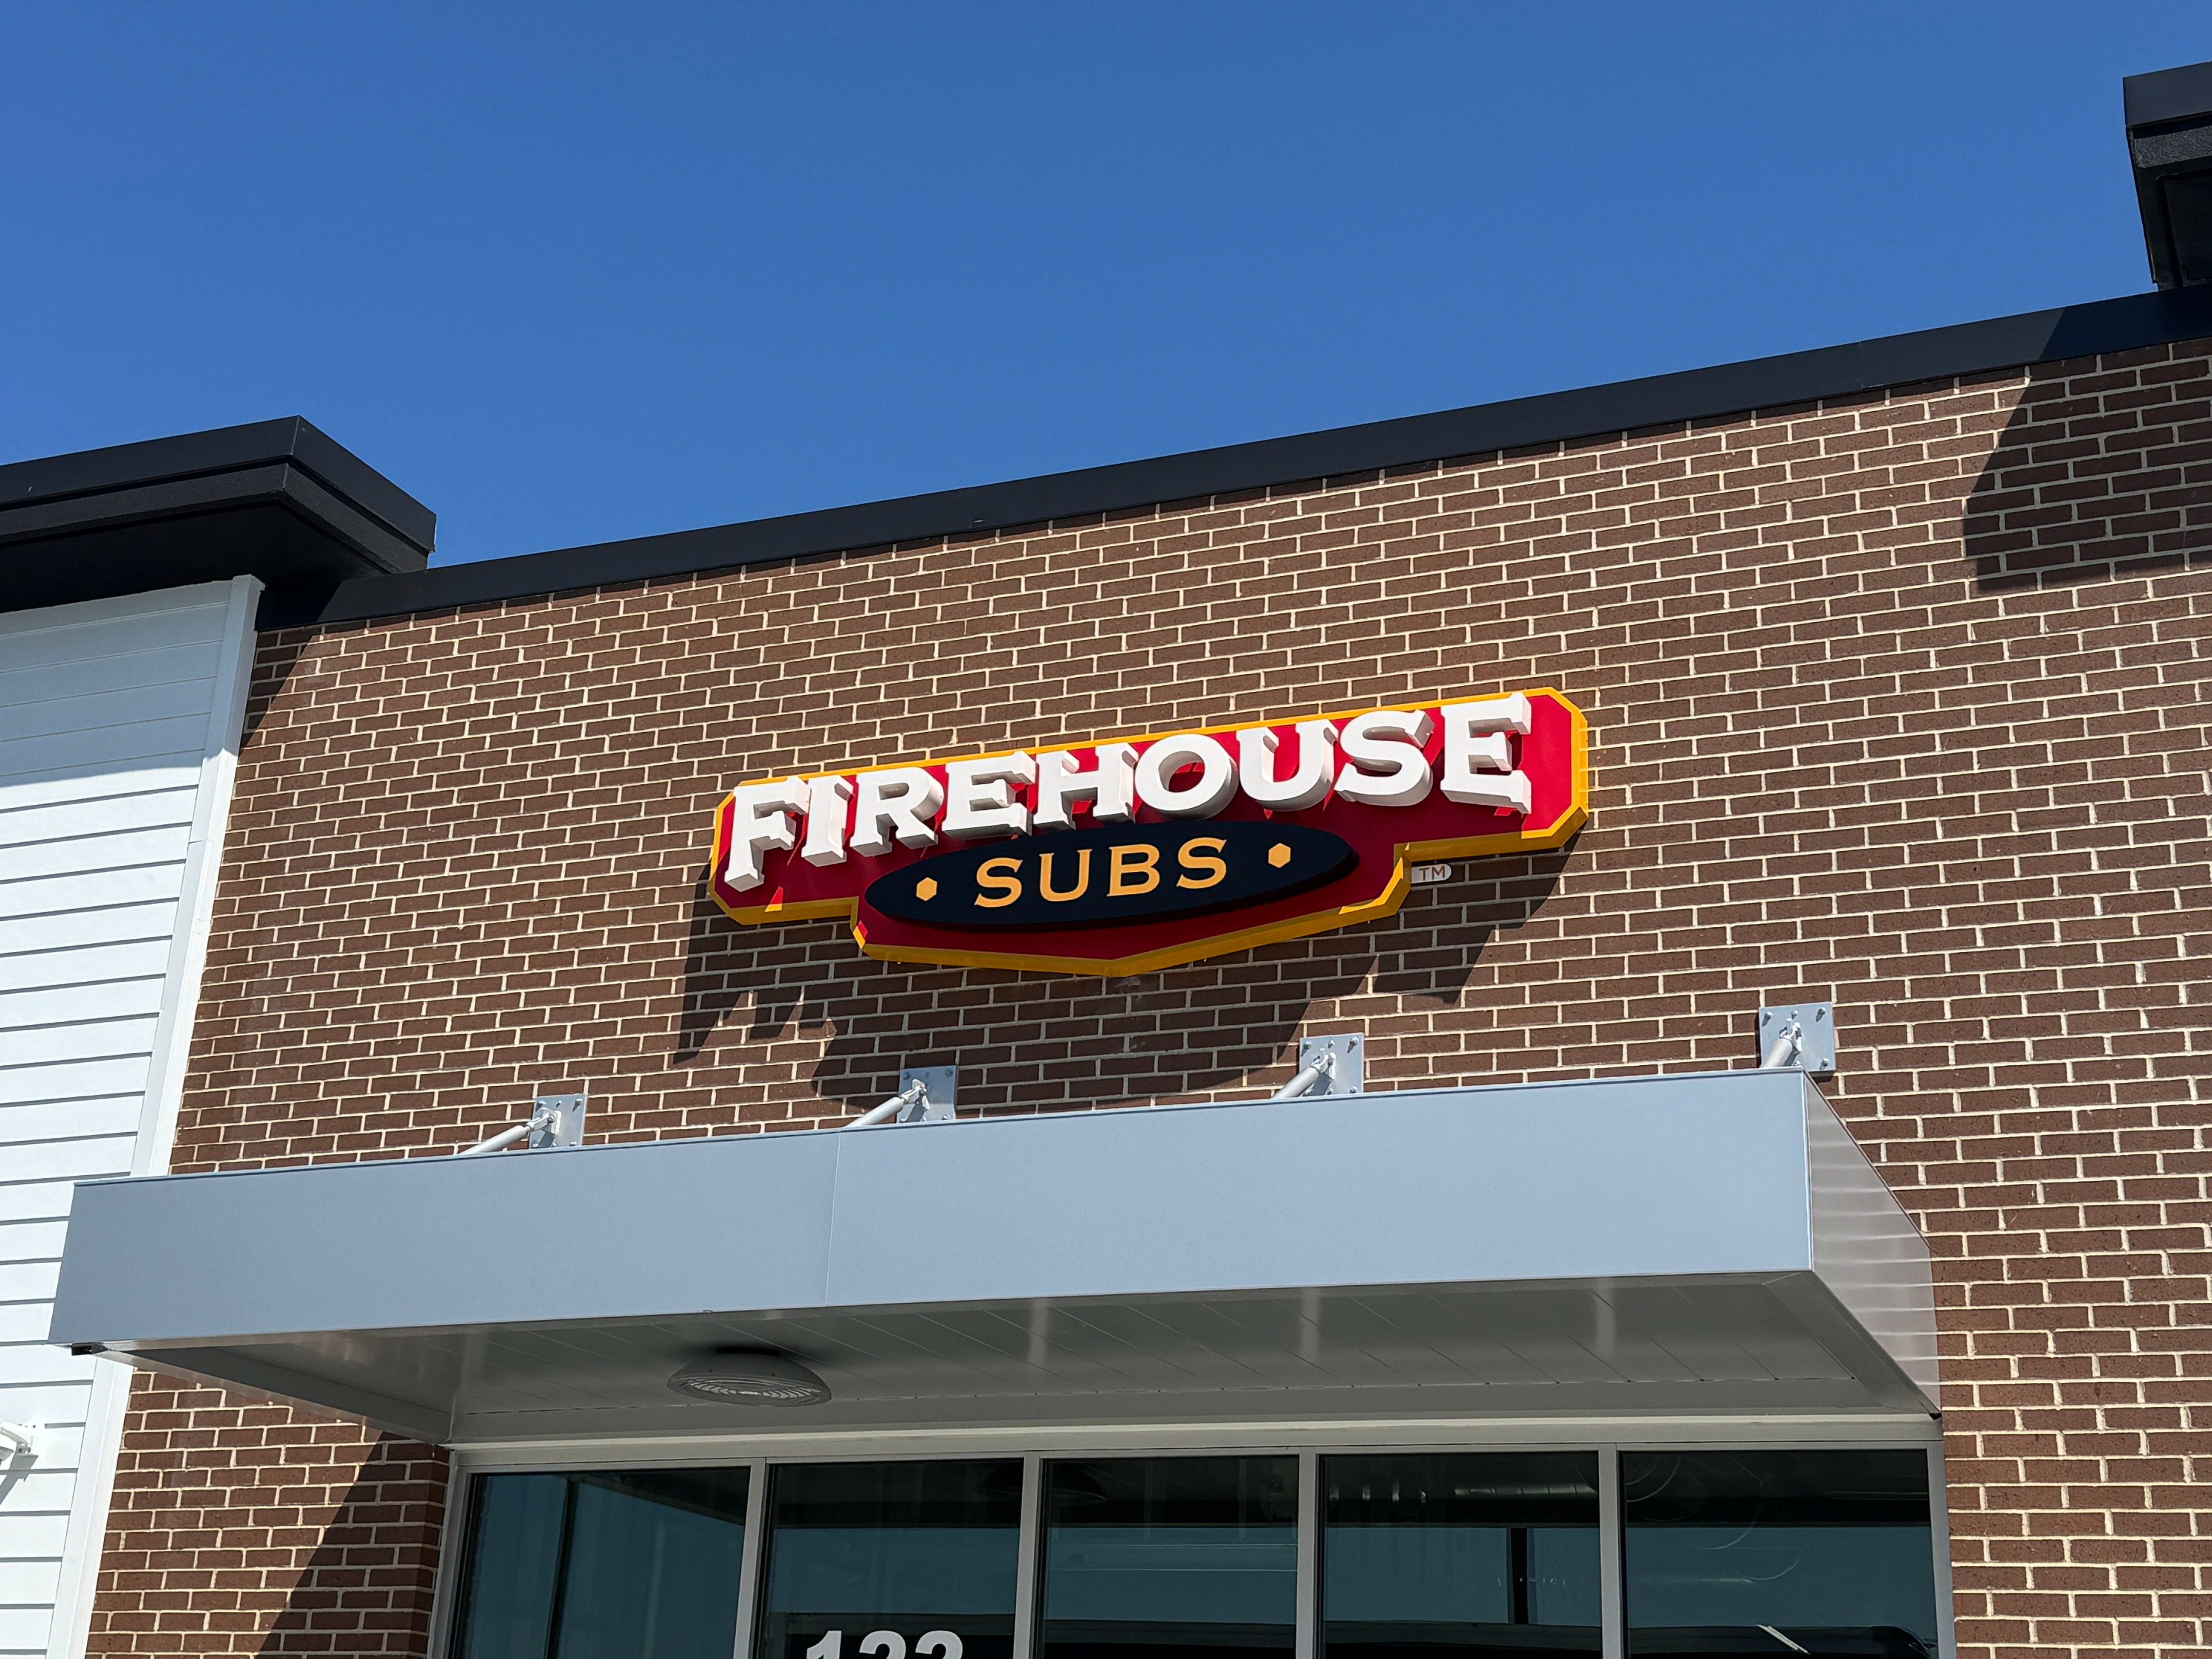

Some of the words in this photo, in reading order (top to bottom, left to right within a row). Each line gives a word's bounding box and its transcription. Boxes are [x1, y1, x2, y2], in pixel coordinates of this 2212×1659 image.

[724, 692, 1532, 892] FIREHOUSE
[974, 837, 1227, 908] SUBS
[1419, 865, 1445, 881] TM
